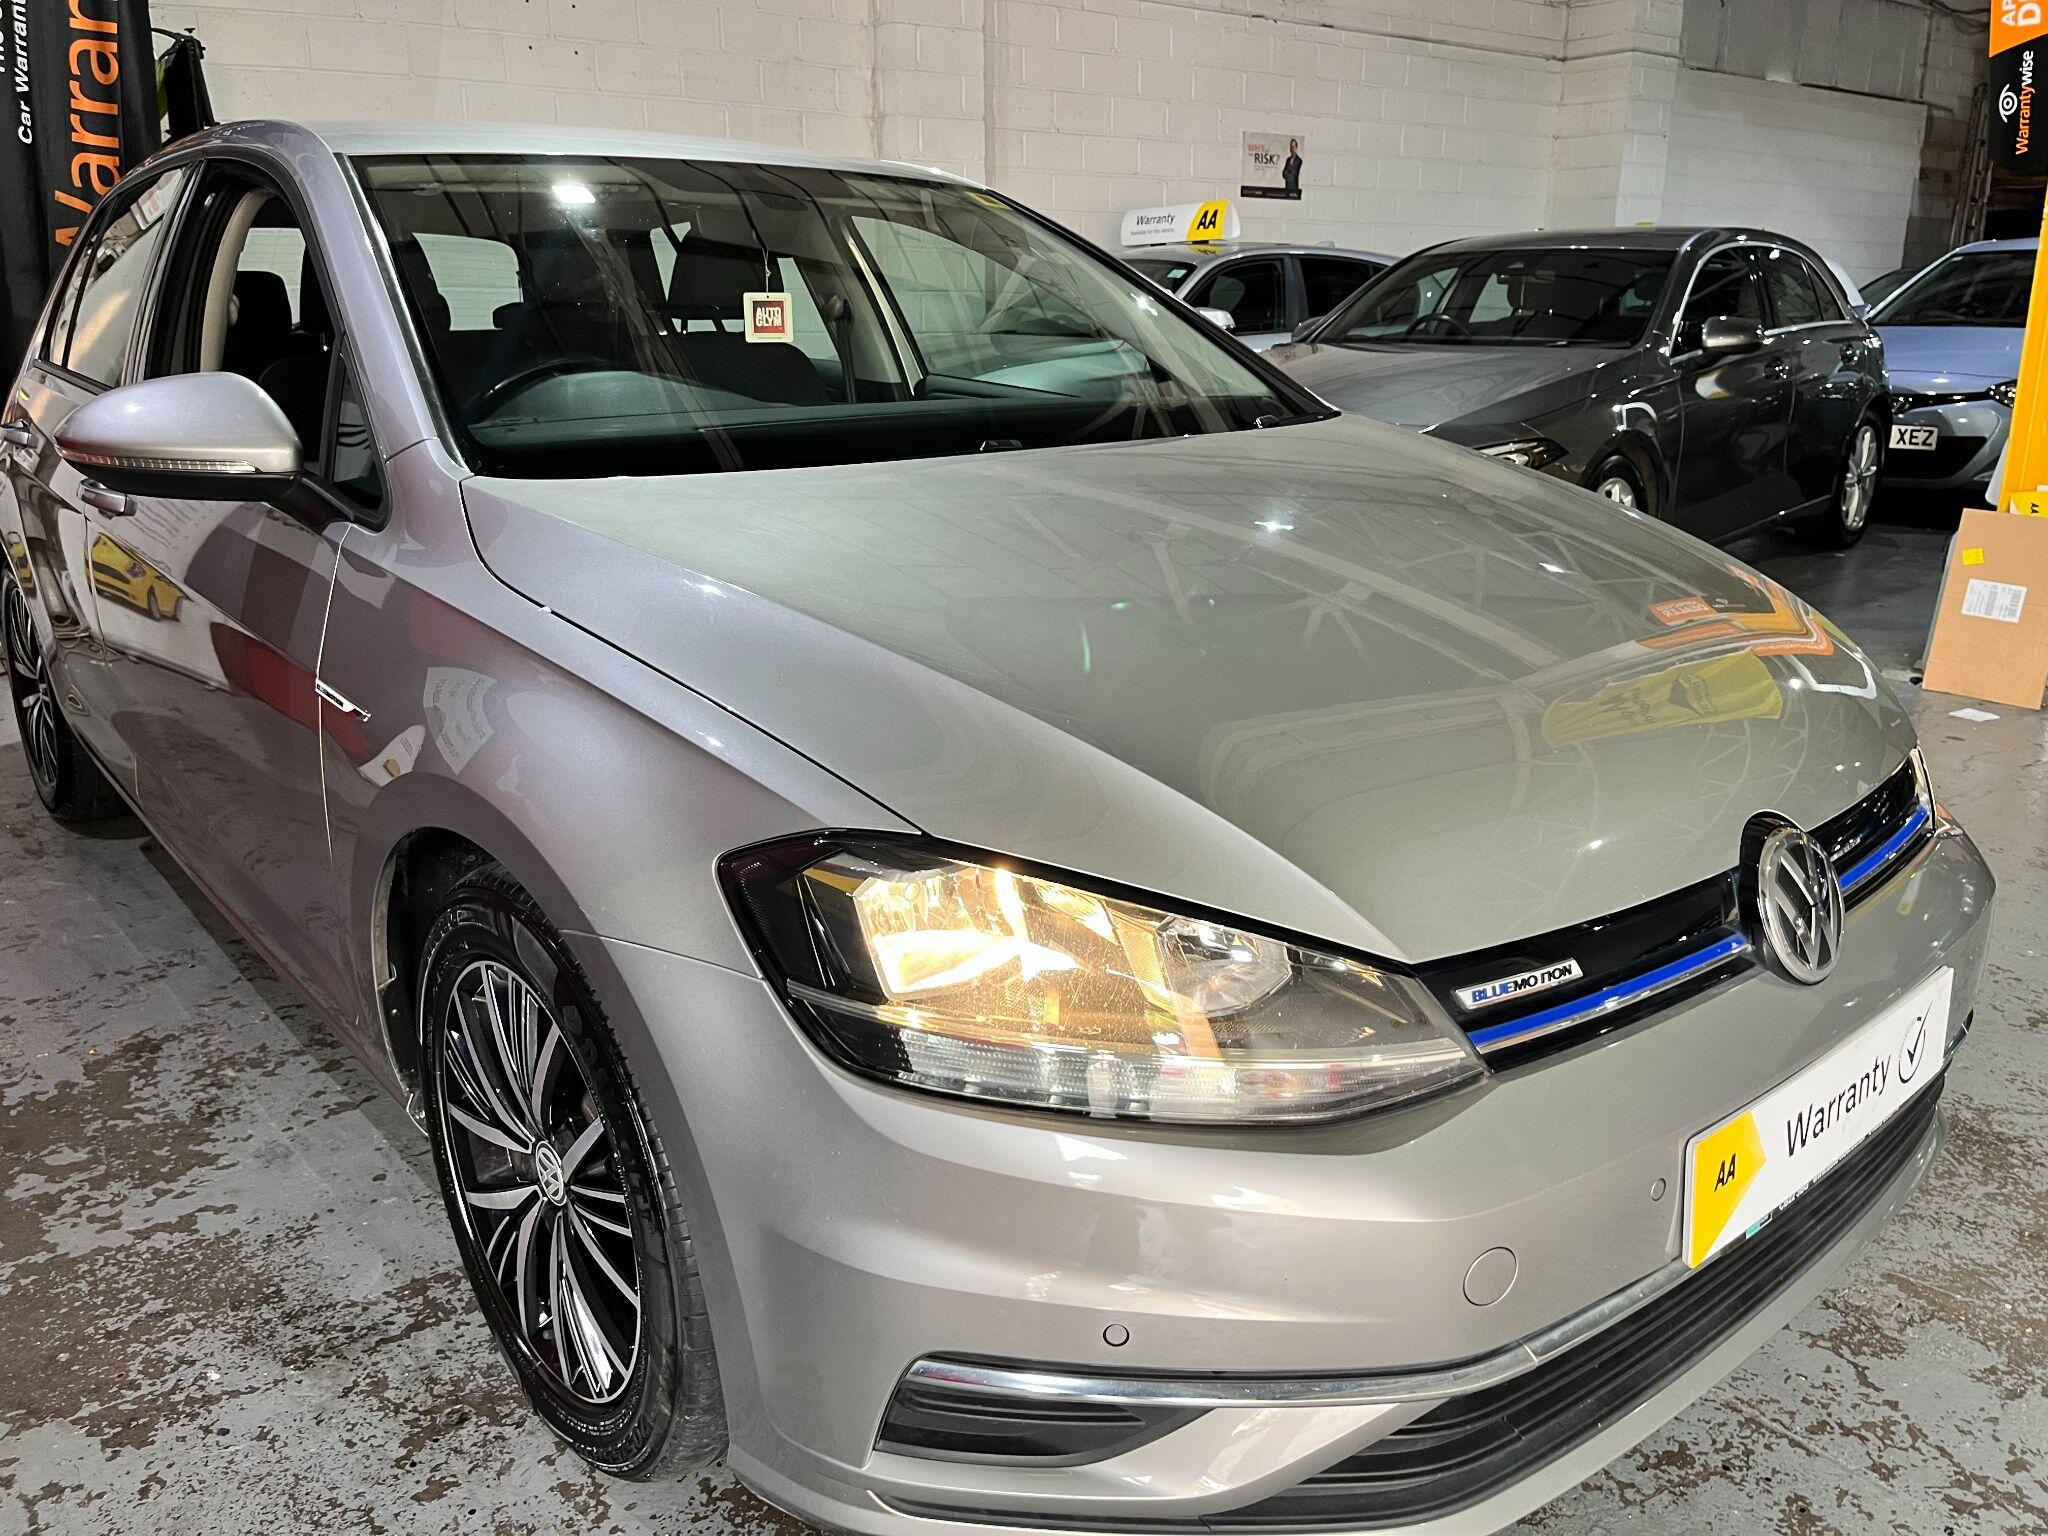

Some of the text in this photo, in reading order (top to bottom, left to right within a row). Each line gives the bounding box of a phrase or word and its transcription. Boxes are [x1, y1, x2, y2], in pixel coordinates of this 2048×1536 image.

[2015, 50, 2036, 154] Warrantywise
[18, 100, 32, 144] Car
[1136, 213, 1175, 226] Warranty
[1197, 209, 1218, 230] AA
[756, 306, 782, 317] AUTO
[1896, 428, 1935, 447] XEZ
[1471, 964, 1572, 1003] BLUEMOTION
[1786, 1055, 1891, 1158] Warranty
[1713, 1153, 1736, 1192] AA
